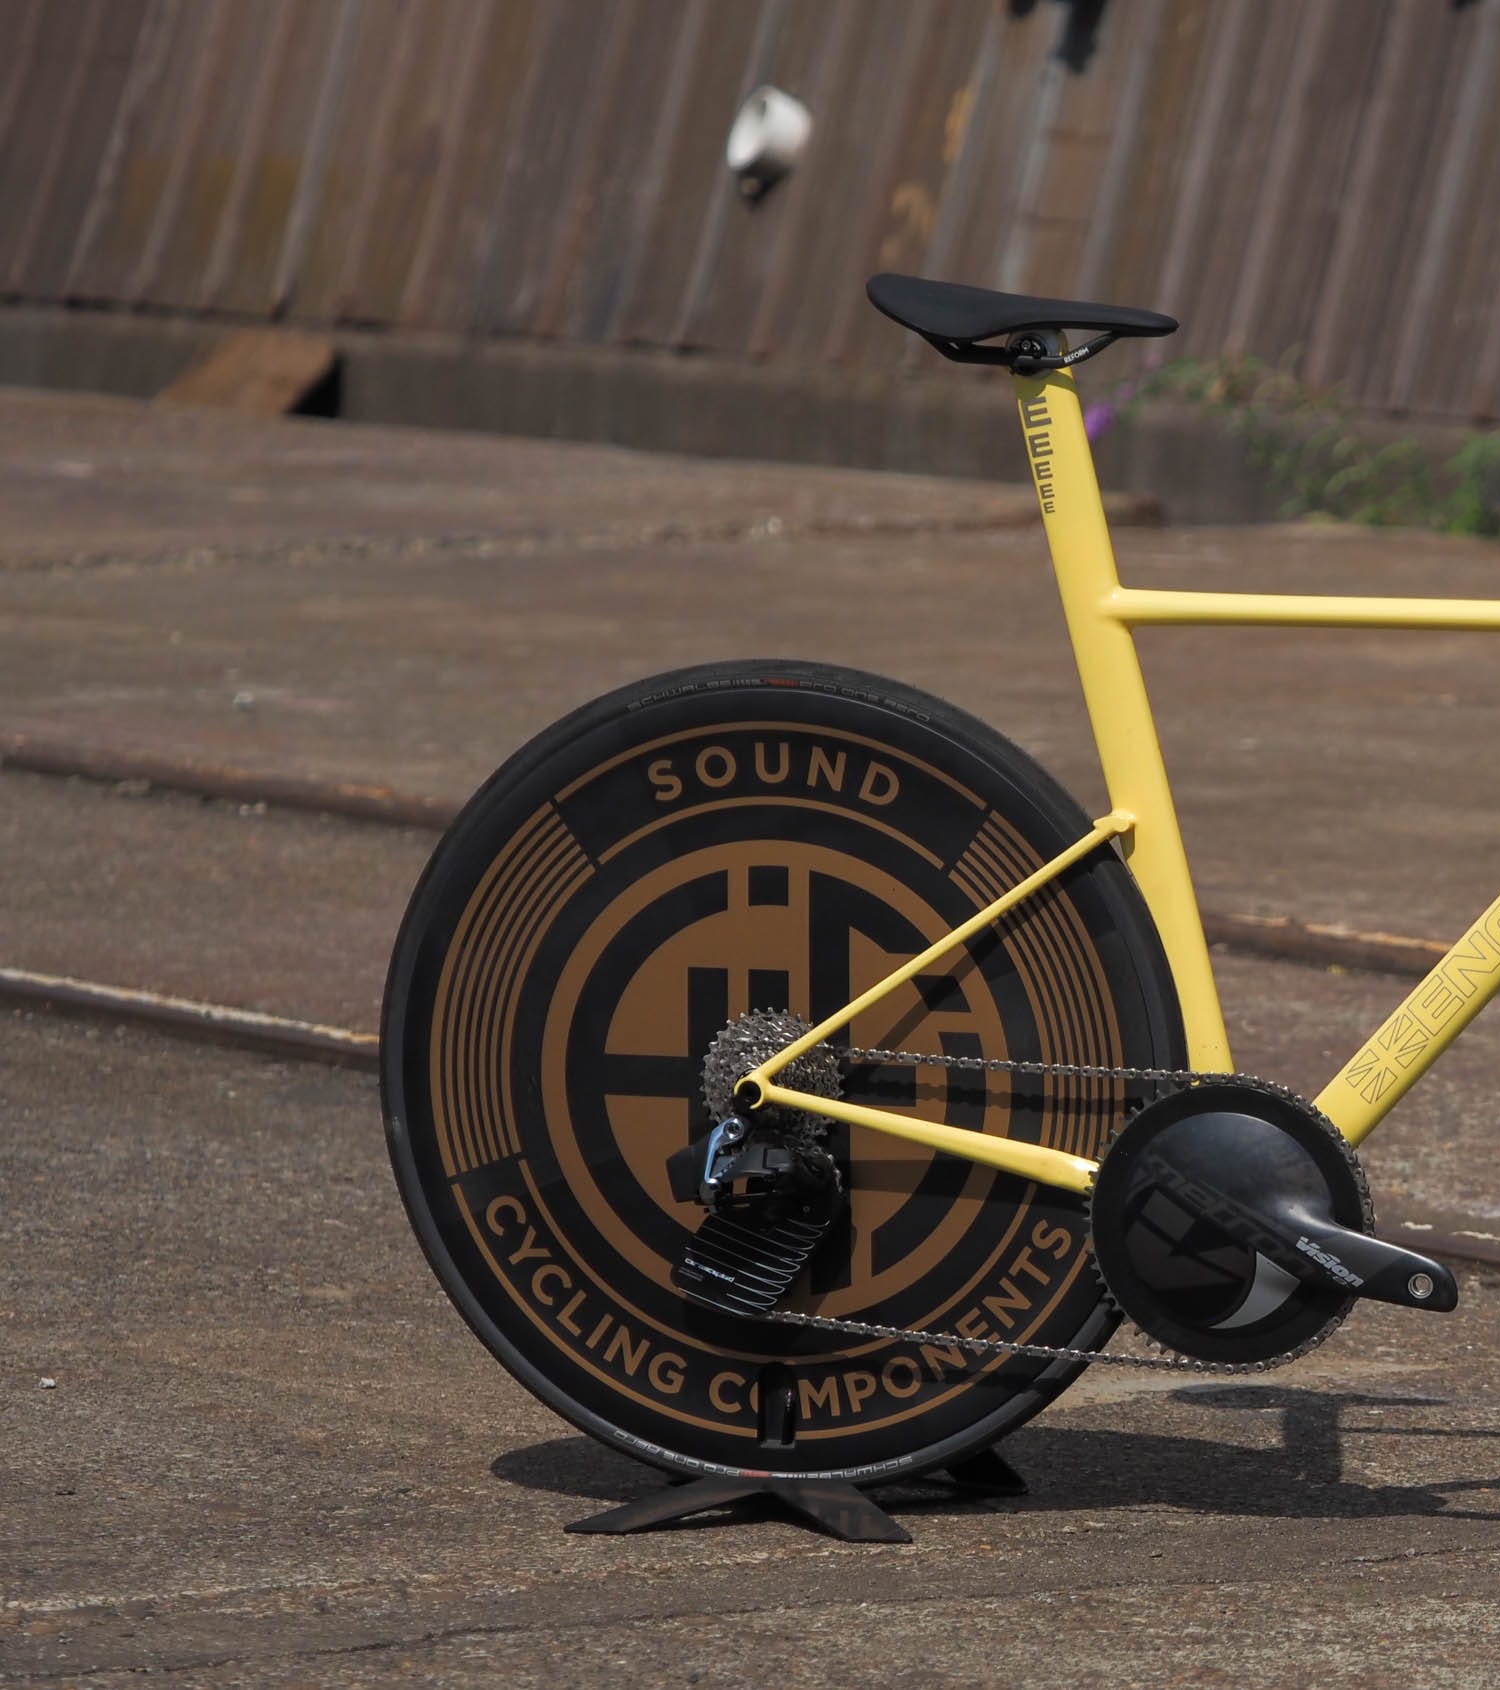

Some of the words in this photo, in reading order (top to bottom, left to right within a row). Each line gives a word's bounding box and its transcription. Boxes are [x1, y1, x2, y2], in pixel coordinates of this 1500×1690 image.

[1063, 346, 1089, 363] REFORM
[649, 741, 901, 806] SOUND
[1296, 1236, 1364, 1287] Vision
[484, 1194, 686, 1397] CYCLING
[708, 1217, 1073, 1420] CMPONENTS
